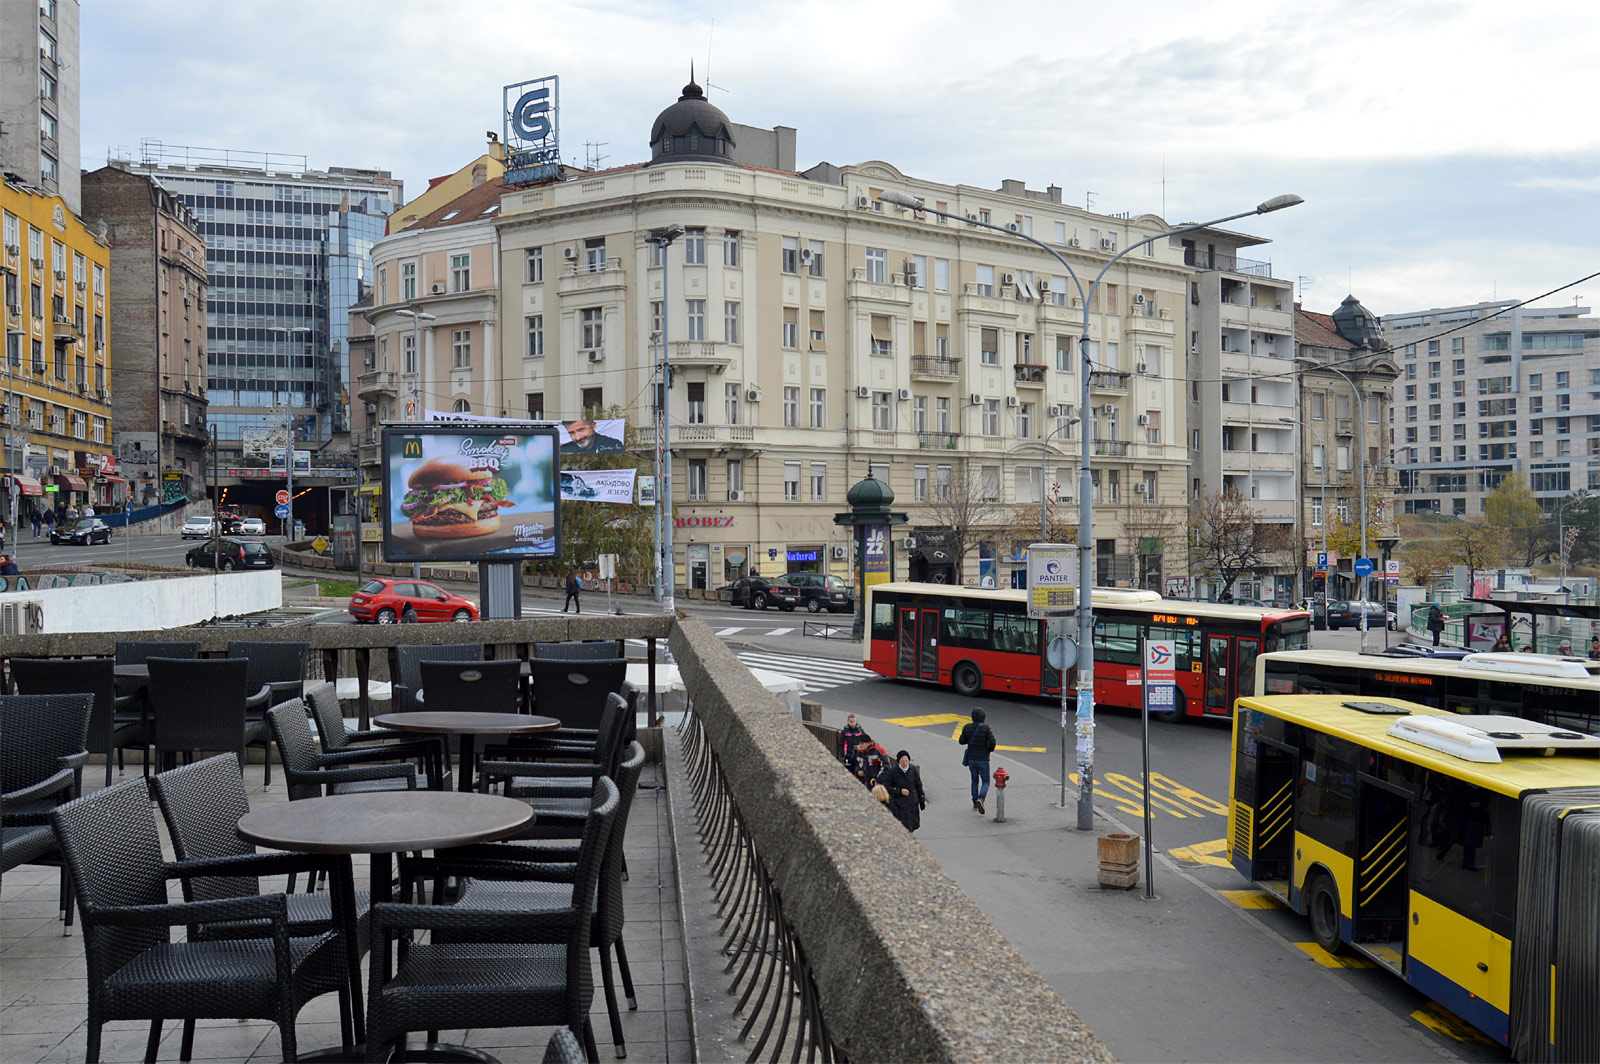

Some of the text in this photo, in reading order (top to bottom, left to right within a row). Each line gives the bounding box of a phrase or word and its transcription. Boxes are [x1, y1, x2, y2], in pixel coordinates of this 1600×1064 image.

[504, 165, 556, 182] SYSTEM
[460, 437, 509, 461] Smokey
[469, 457, 500, 473] BBQ
[513, 522, 544, 537] Maestro
[867, 528, 884, 542] JA
[786, 551, 818, 561] Natural
[866, 542, 884, 555] ZZ
